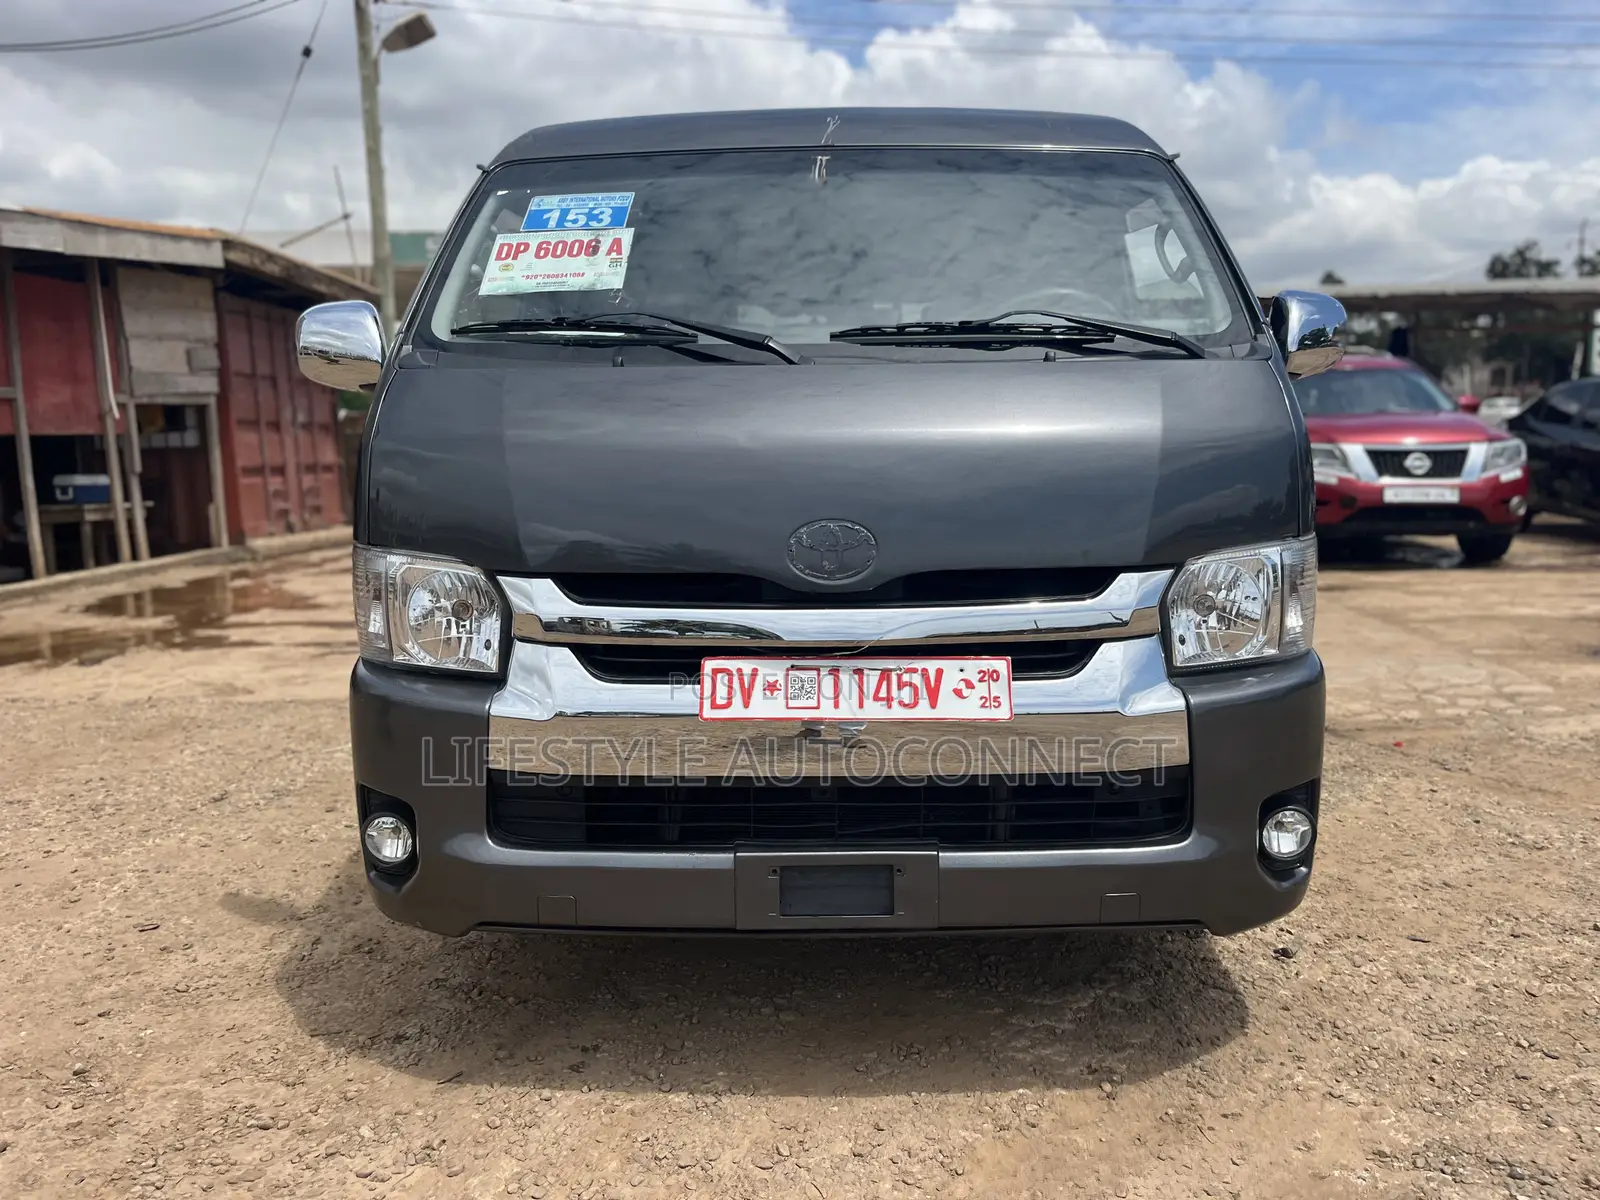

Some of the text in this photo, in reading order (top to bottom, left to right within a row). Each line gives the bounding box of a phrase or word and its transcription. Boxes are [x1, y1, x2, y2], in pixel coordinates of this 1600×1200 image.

[542, 207, 613, 229] 153
[495, 237, 623, 261] DP 6006 A
[710, 667, 944, 709] DV 1145V
